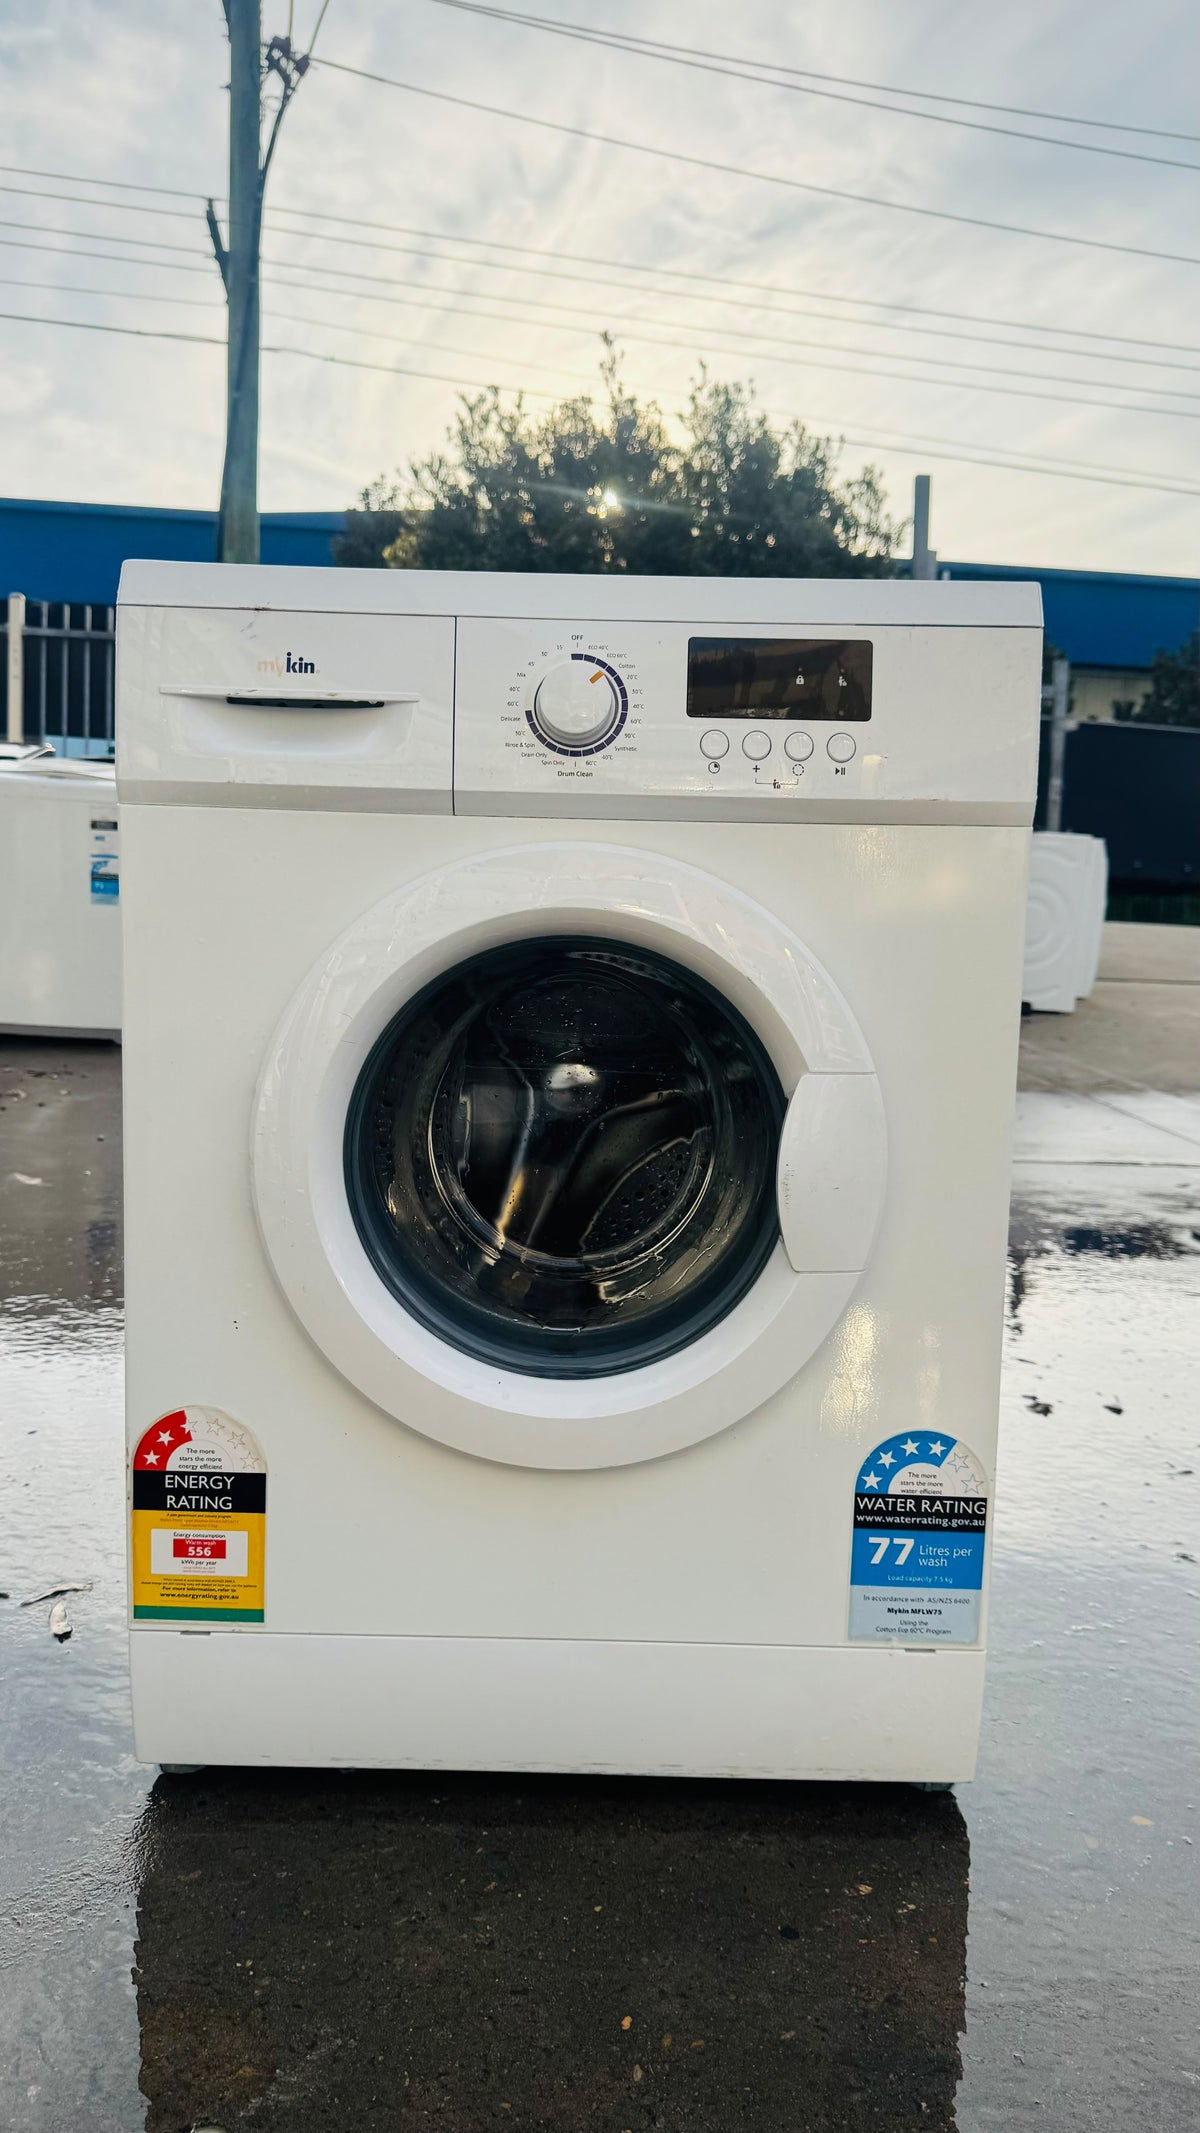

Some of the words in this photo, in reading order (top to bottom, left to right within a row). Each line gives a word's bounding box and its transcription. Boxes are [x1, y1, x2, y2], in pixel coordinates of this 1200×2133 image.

[164, 1475, 235, 1490] ENERGY
[166, 1495, 233, 1510] RATING
[857, 1497, 917, 1513] WATER
[921, 1499, 986, 1515] RATING
[856, 1514, 985, 1527] www.waterrating.gov.au
[187, 1547, 212, 1556] 556
[868, 1536, 915, 1566] 77
[919, 1545, 950, 1556] Litres
[953, 1548, 973, 1558] per
[918, 1557, 948, 1567] wash
[905, 1575, 932, 1583] capacity
[160, 1592, 239, 1600] www.energyrating.gov.au
[887, 1607, 910, 1615] Mykin
[925, 1628, 952, 1636] Program
